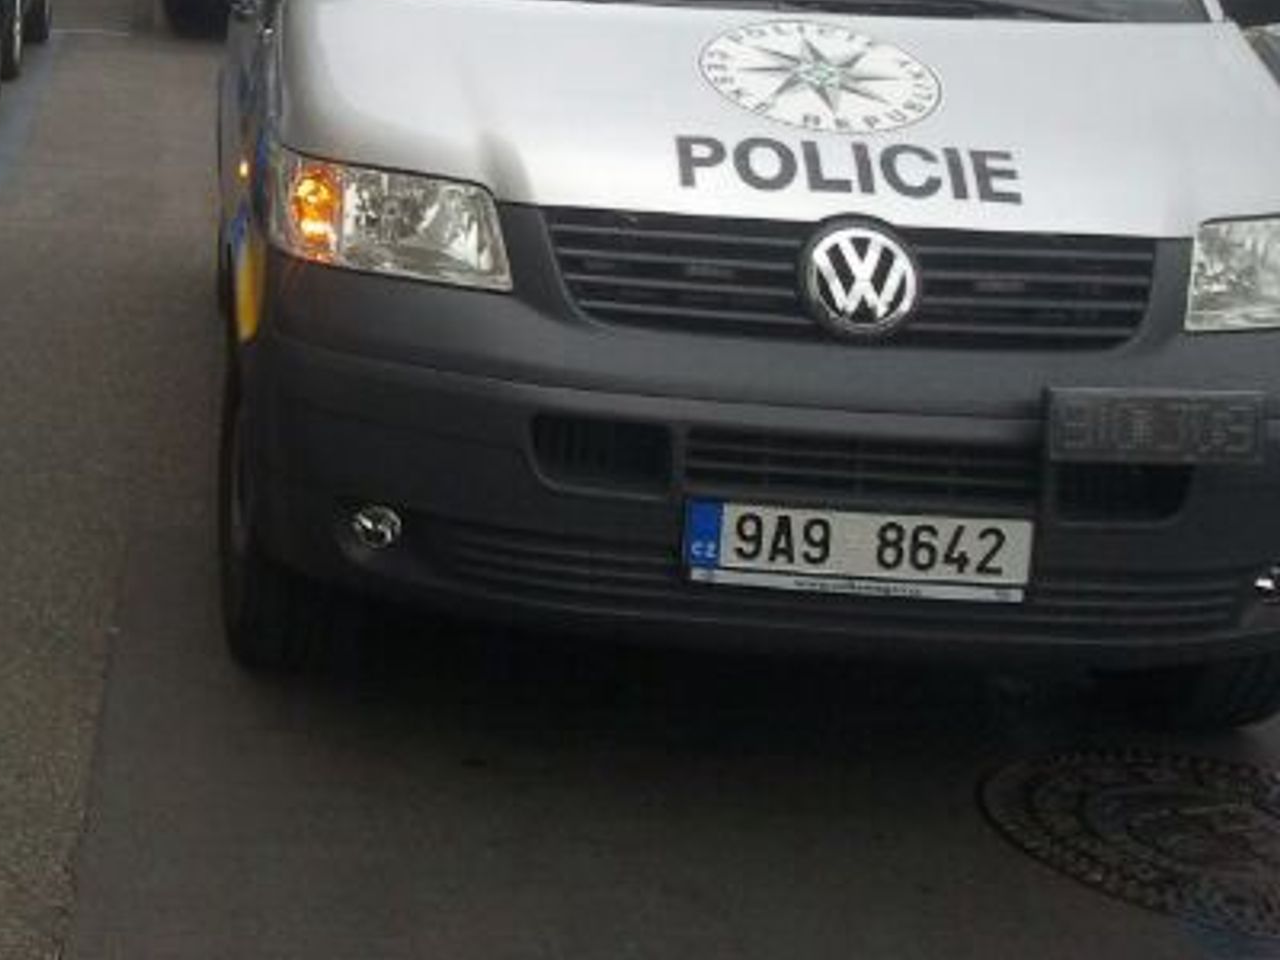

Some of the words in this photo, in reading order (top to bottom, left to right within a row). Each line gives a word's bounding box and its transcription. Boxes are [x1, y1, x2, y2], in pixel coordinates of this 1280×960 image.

[676, 134, 1022, 205] POLICIE
[733, 512, 833, 566] 9A9
[875, 521, 1008, 576] 8642
